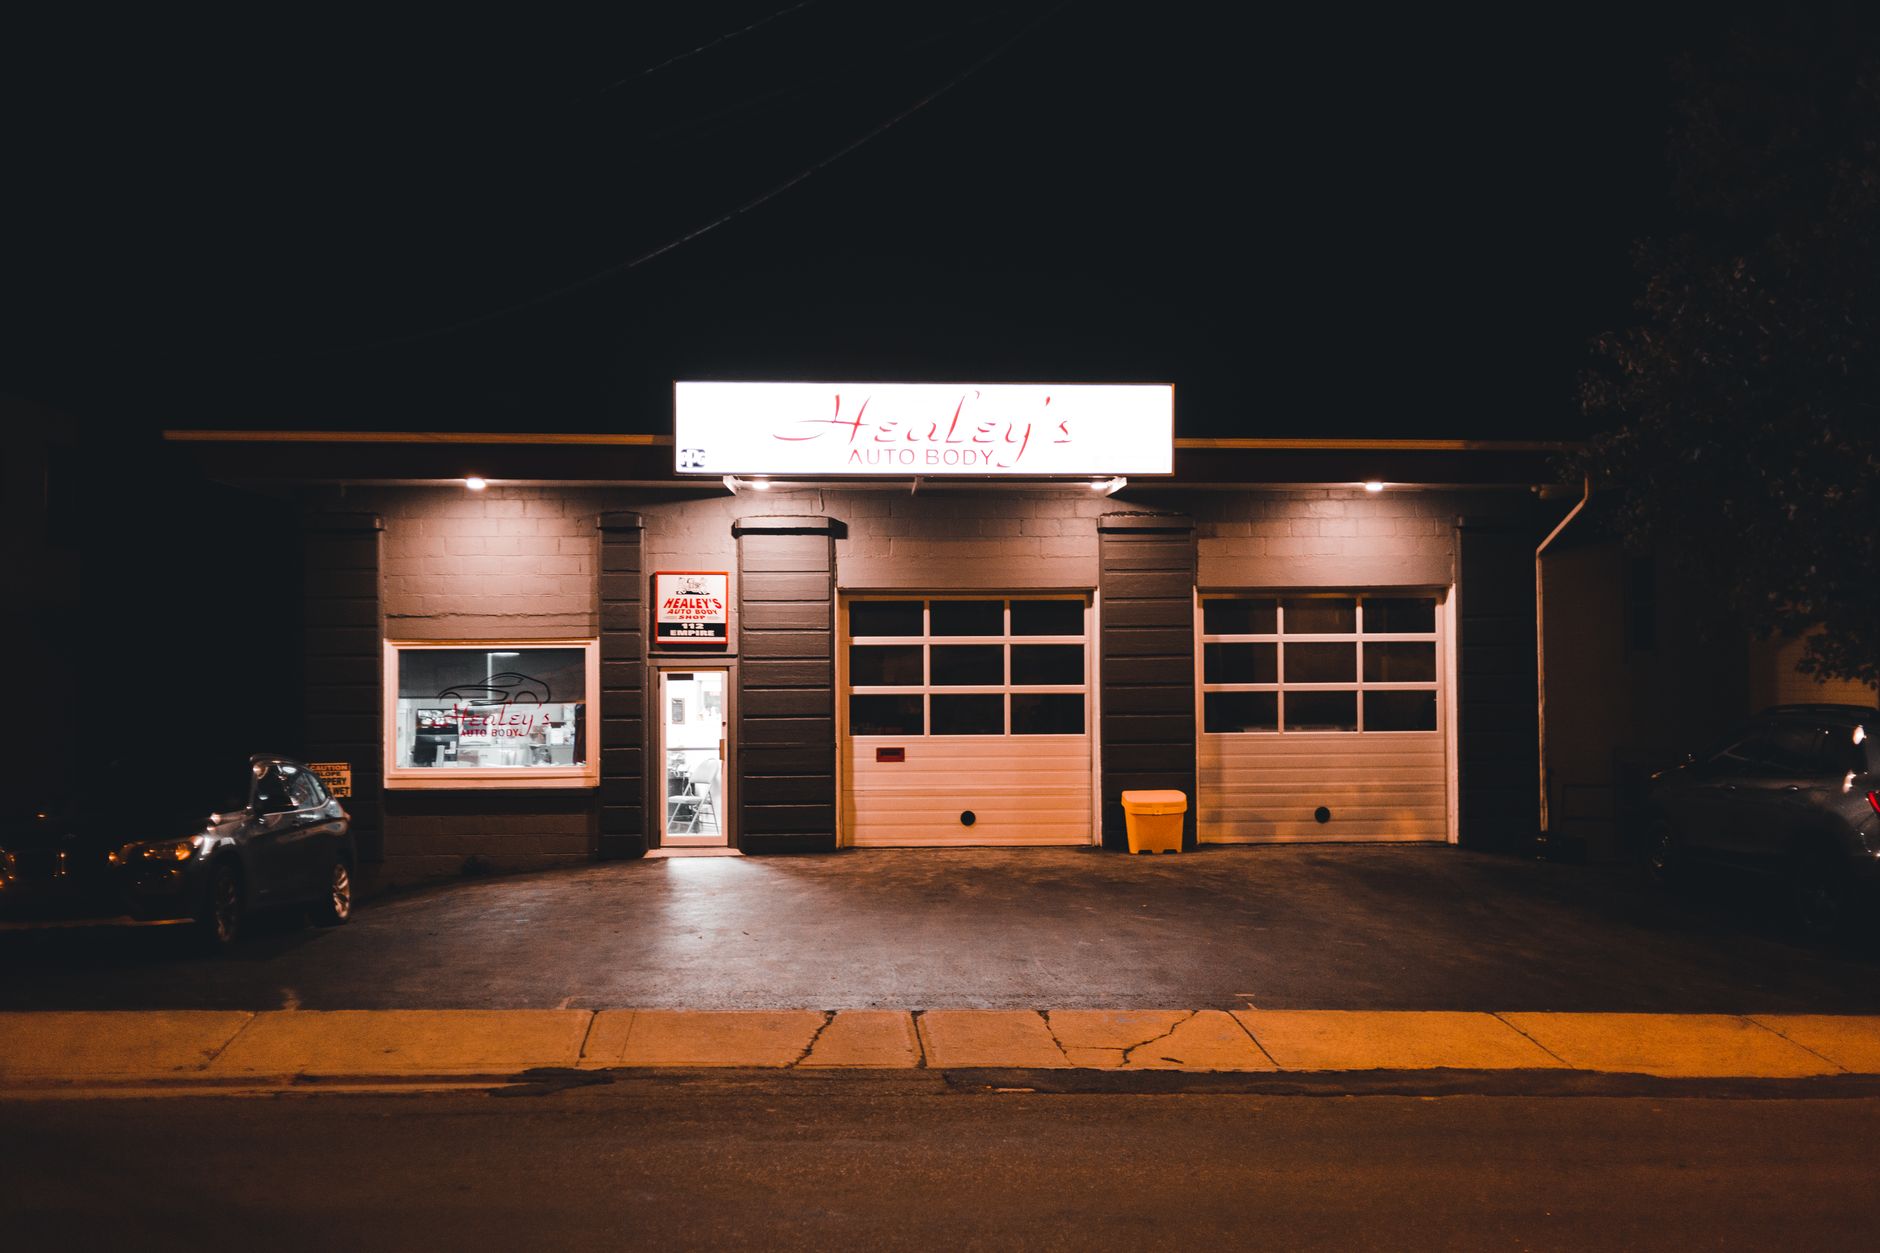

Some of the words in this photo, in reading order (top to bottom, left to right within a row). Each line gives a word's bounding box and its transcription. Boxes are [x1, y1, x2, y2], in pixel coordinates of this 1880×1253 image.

[773, 390, 1073, 469] Healey's
[848, 448, 915, 465] AUTO
[925, 448, 994, 465] BODY
[664, 598, 722, 609] HEALEY'S
[433, 701, 551, 736] Healey's
[460, 729, 487, 737] AUTO
[491, 729, 519, 737] BODY
